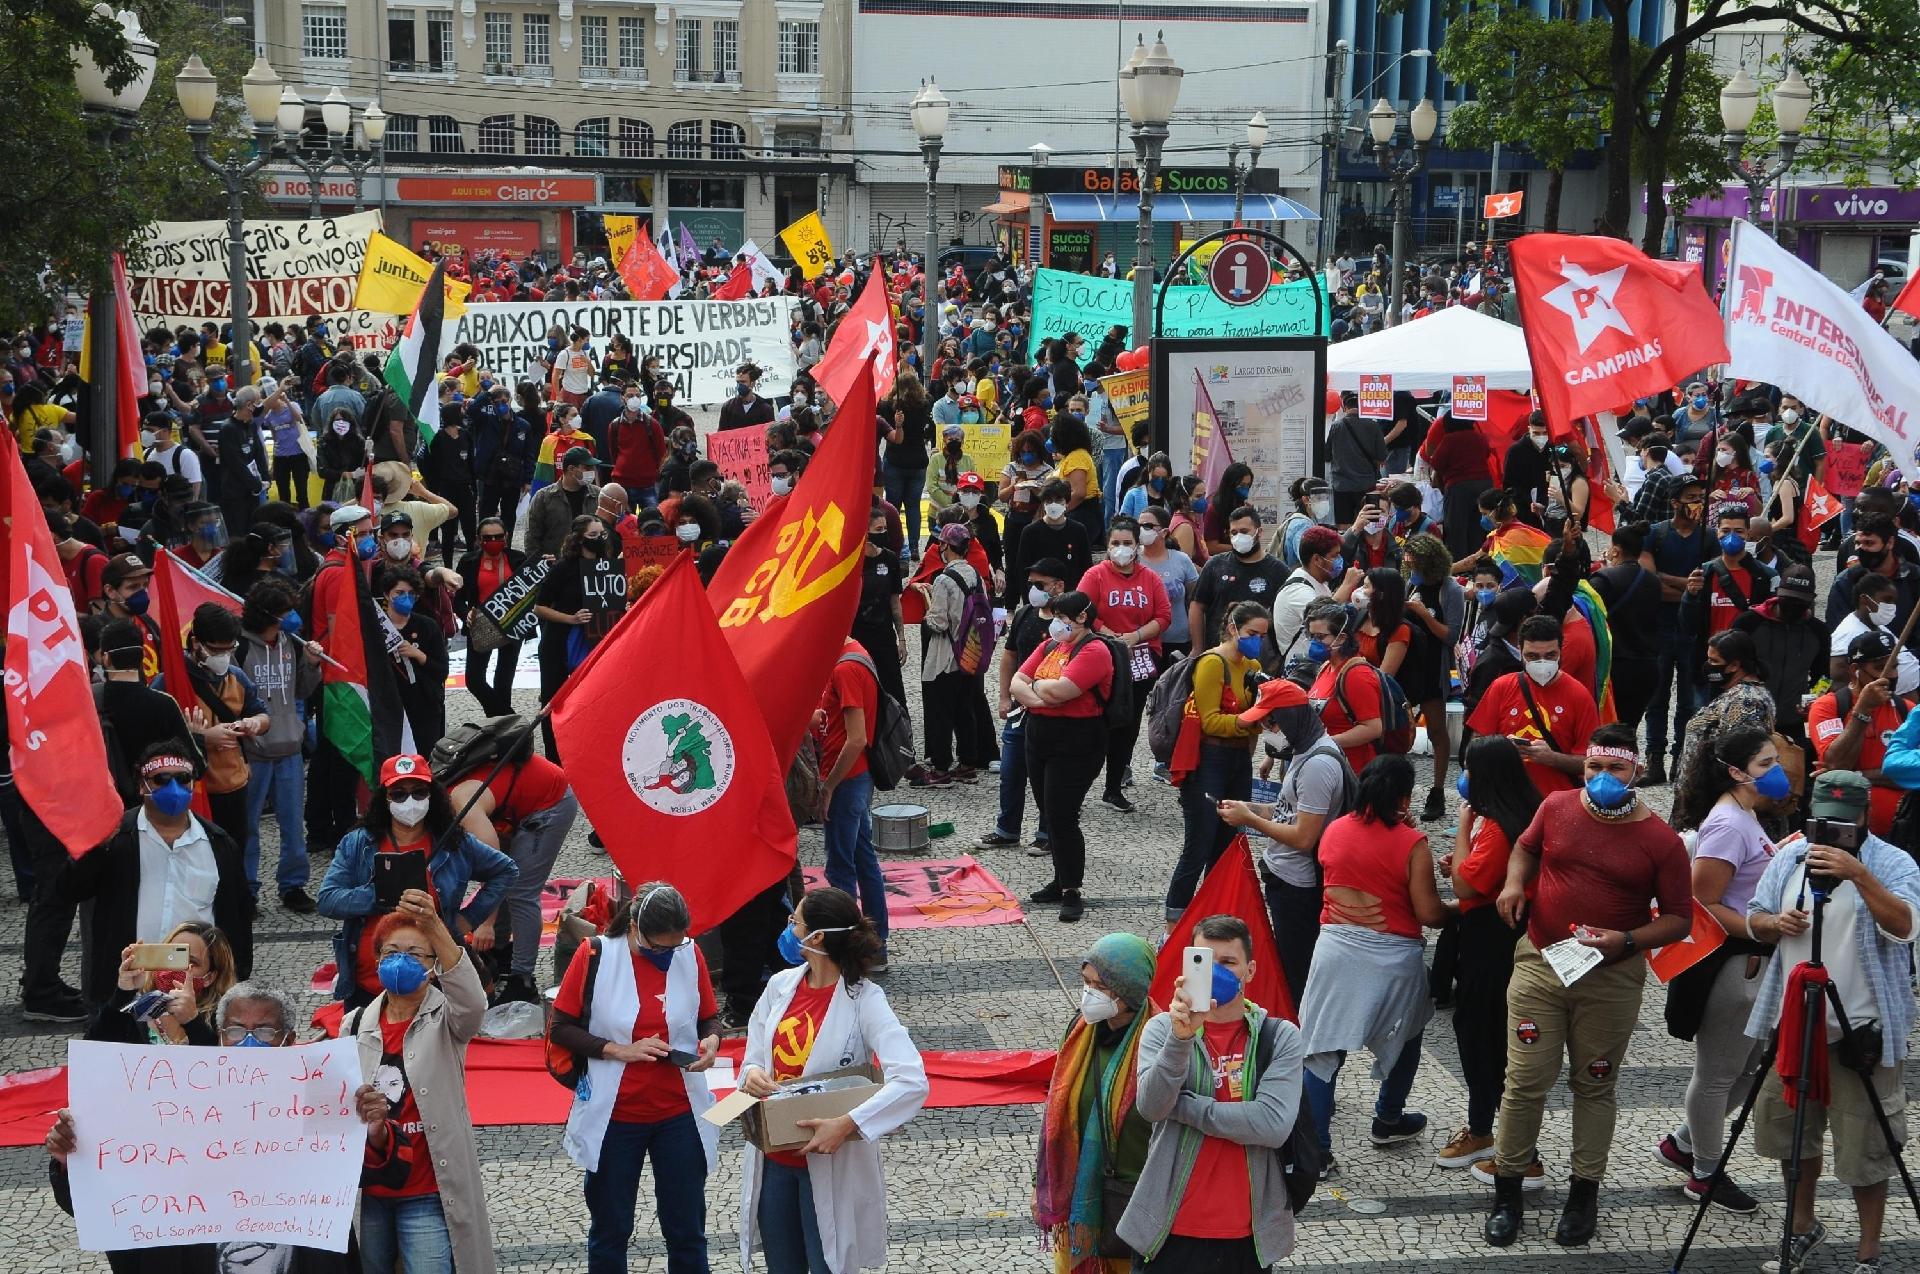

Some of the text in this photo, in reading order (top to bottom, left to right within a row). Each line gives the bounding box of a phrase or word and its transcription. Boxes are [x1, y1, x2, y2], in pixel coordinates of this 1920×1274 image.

[497, 183, 552, 200] Claro
[1168, 170, 1229, 191] Sucos
[1834, 195, 1889, 216] vivo
[298, 223, 312, 245] e
[323, 219, 340, 240] a
[805, 248, 820, 265] 50
[360, 312, 372, 328] e
[455, 309, 548, 344] ABAIXO
[658, 304, 685, 336] DE
[691, 301, 777, 333] VERBAS!
[1042, 315, 1105, 340] educaçã
[1771, 321, 1818, 351] Central
[1818, 342, 1833, 357] da
[1564, 338, 1662, 385] CAMPINAS
[1360, 391, 1392, 400] BOLSO
[1362, 383, 1389, 392] FORA
[1453, 392, 1486, 401] BOLSO
[1456, 384, 1483, 393] FORA
[1362, 399, 1390, 408] NARO
[1455, 400, 1483, 409] NARO
[596, 557, 610, 571] do
[484, 575, 535, 620] BRASIL
[584, 574, 626, 597] LUTO
[1108, 587, 1148, 609] GAP
[28, 587, 77, 651] PT
[506, 612, 539, 641] VIRO
[1141, 648, 1155, 673] FORA
[667, 701, 685, 710] DOS
[627, 706, 663, 744] MOVIMENTO
[689, 703, 733, 759] TRABALHADORES
[627, 772, 645, 798] BRASIL
[716, 763, 732, 792] RURAIS
[700, 793, 717, 807] SEM
[152, 1101, 222, 1127] PRA
[97, 1138, 190, 1170] FORA
[112, 1193, 208, 1227] FORA
